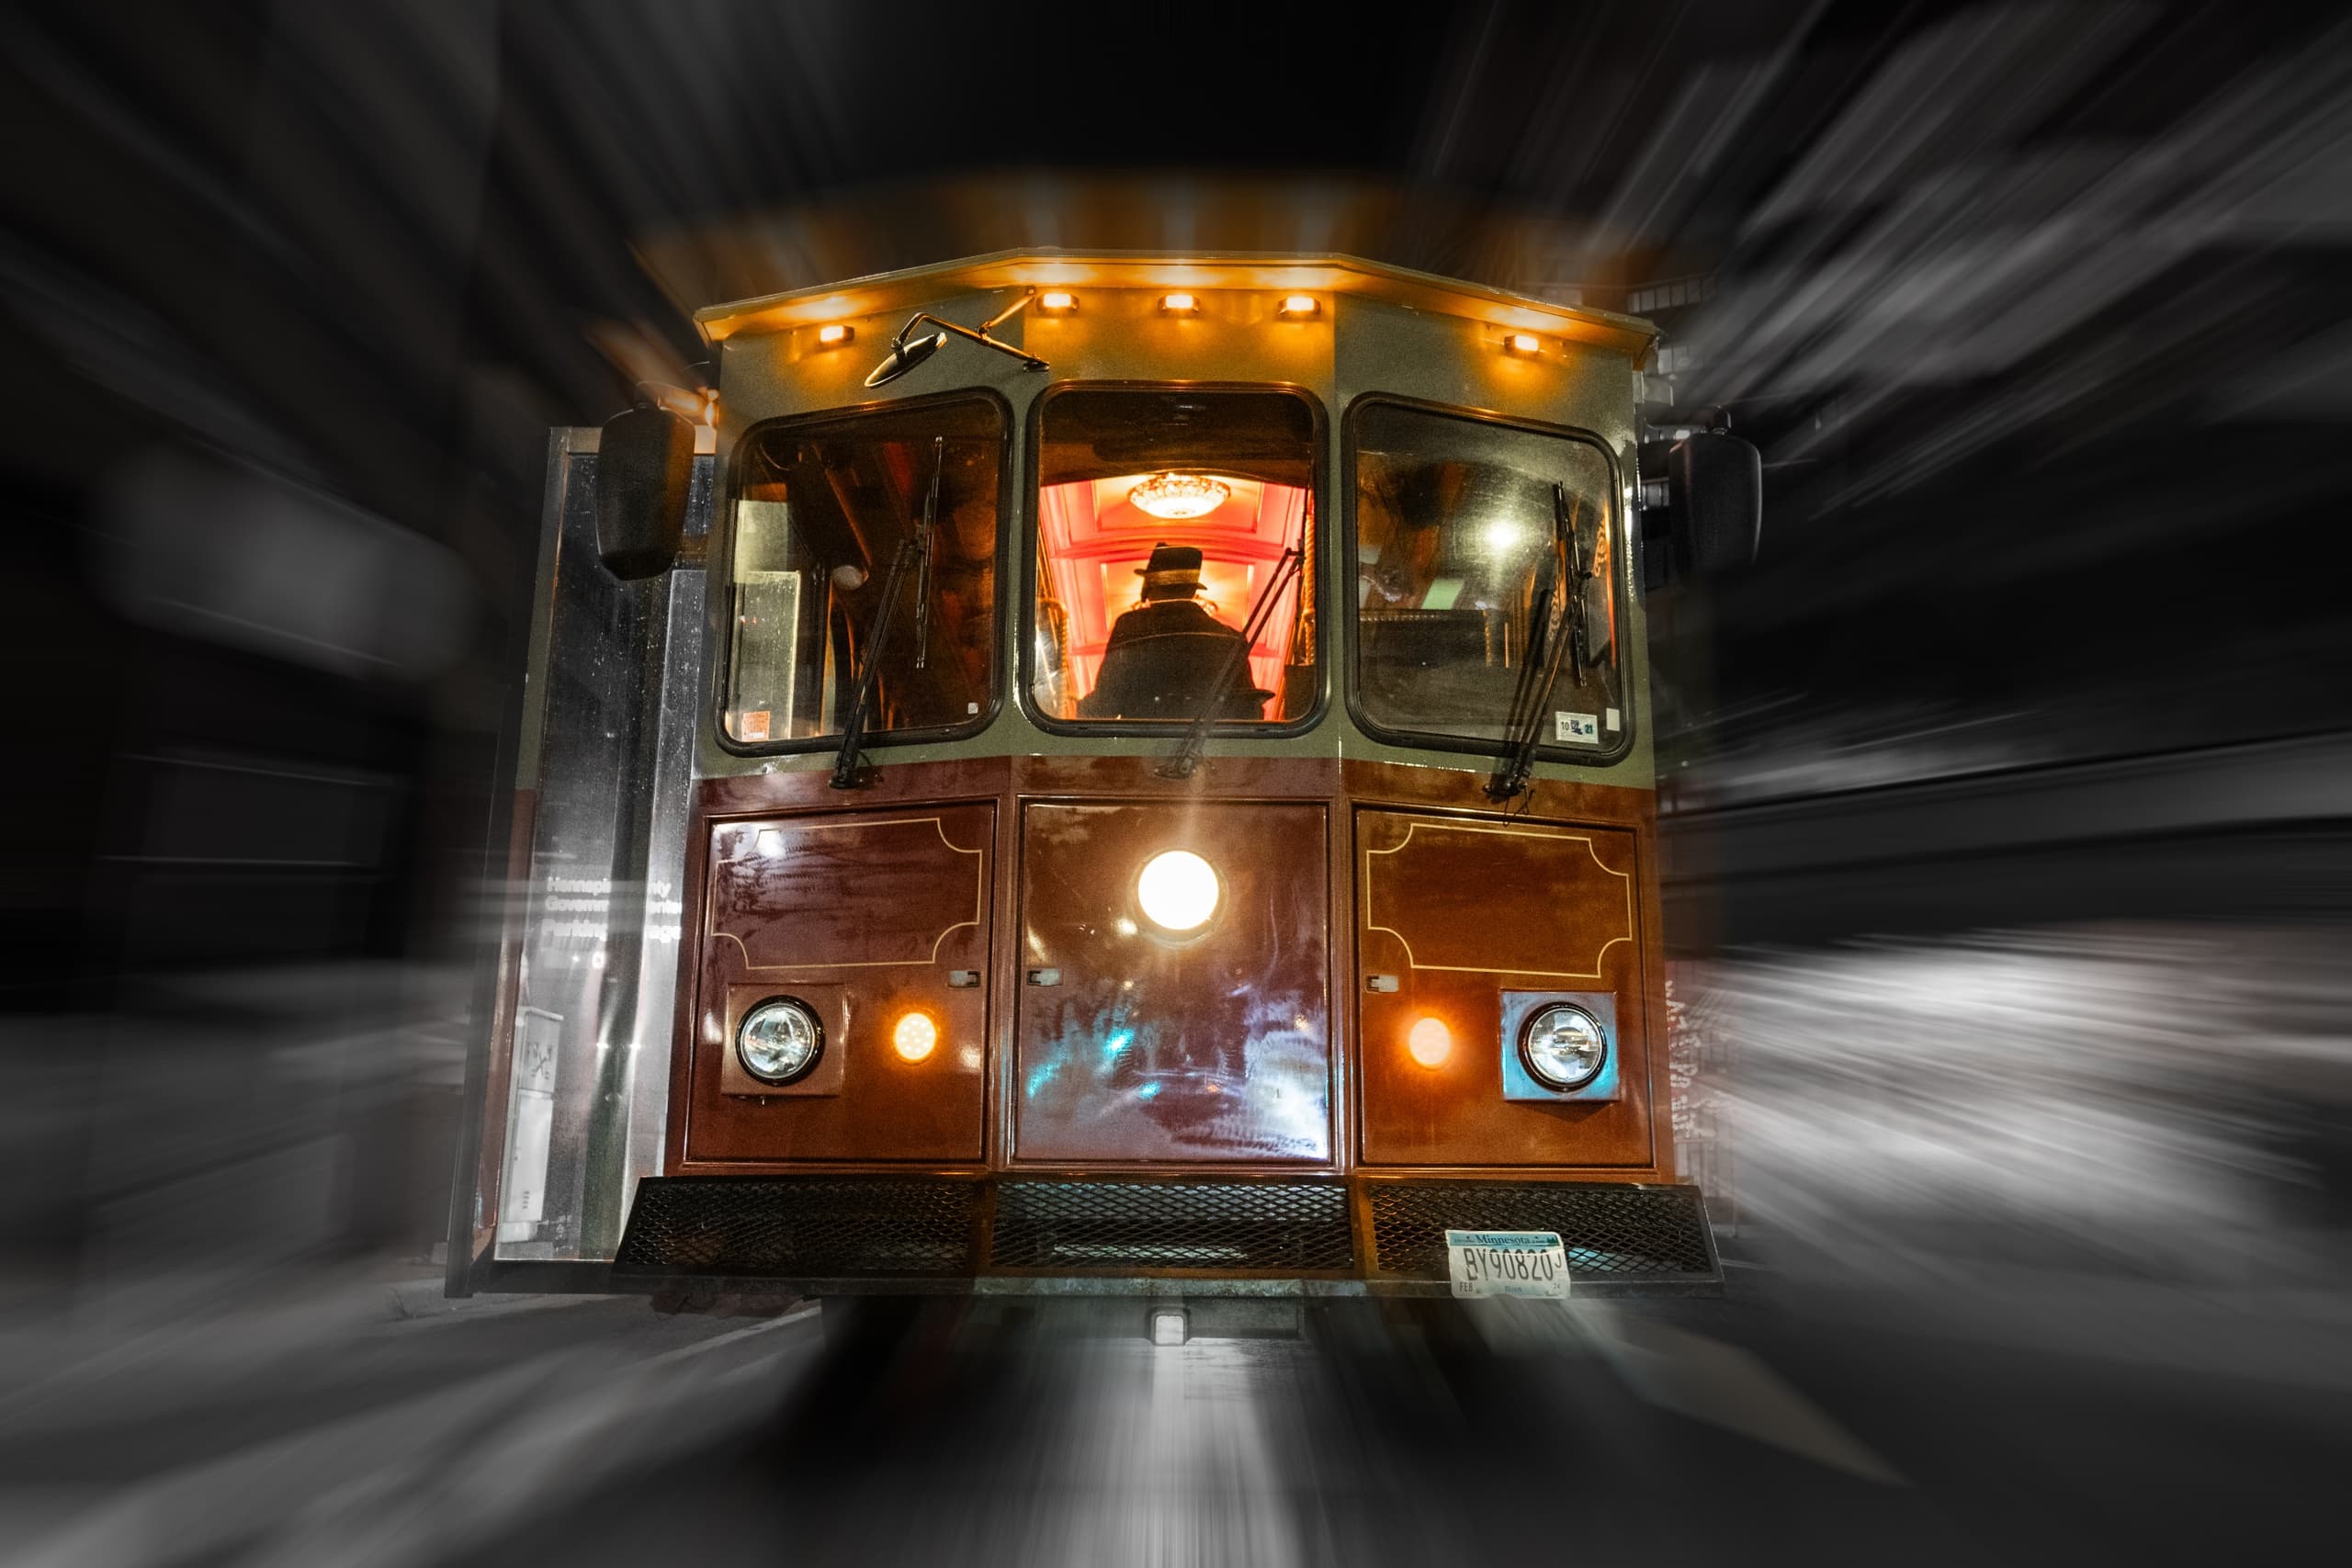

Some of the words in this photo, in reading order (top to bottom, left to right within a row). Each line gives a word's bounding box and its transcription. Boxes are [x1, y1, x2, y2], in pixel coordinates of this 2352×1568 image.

[1561, 721, 1569, 730] 10
[547, 876, 611, 897] Hennepi
[1476, 1235, 1531, 1246] Minnesota
[1460, 1282, 1474, 1292] FEB
